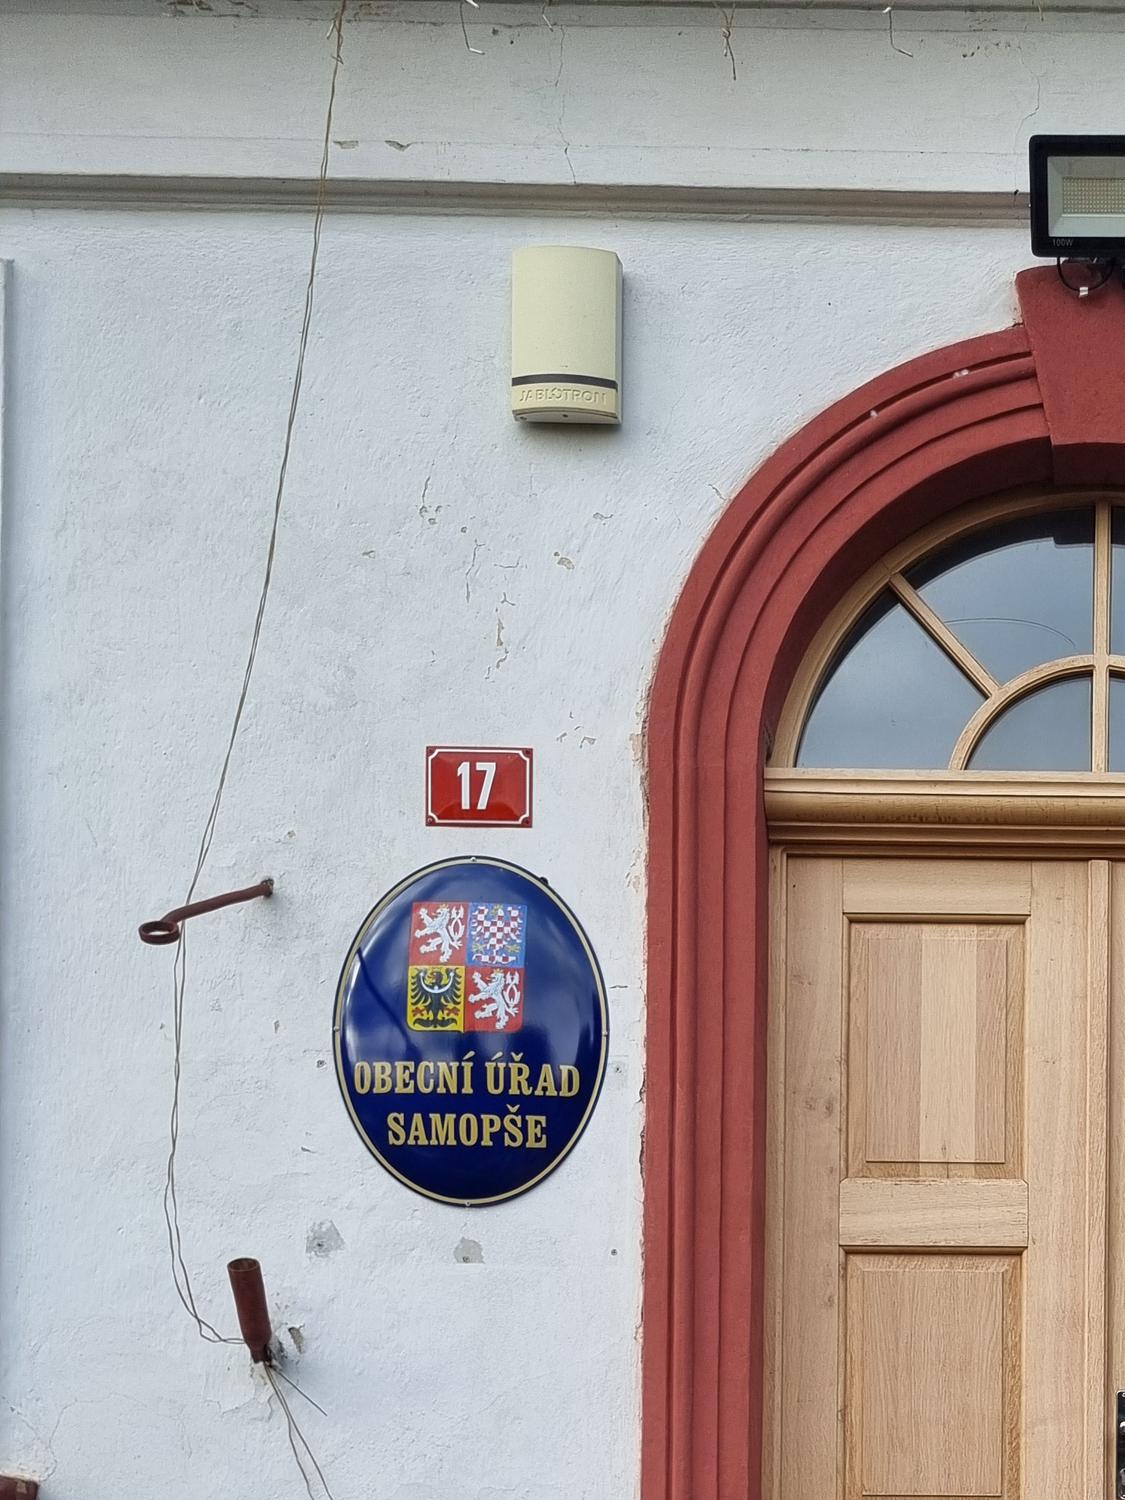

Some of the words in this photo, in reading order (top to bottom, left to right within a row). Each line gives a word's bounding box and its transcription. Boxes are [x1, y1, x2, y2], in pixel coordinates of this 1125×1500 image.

[1052, 238, 1074, 247] 100W
[519, 387, 607, 405] JABLOTRON
[457, 761, 498, 810] 17
[353, 1051, 473, 1095] OBECNÍ
[485, 1052, 580, 1098] ÚŘAD
[387, 1104, 548, 1149] SAMOPŠE
